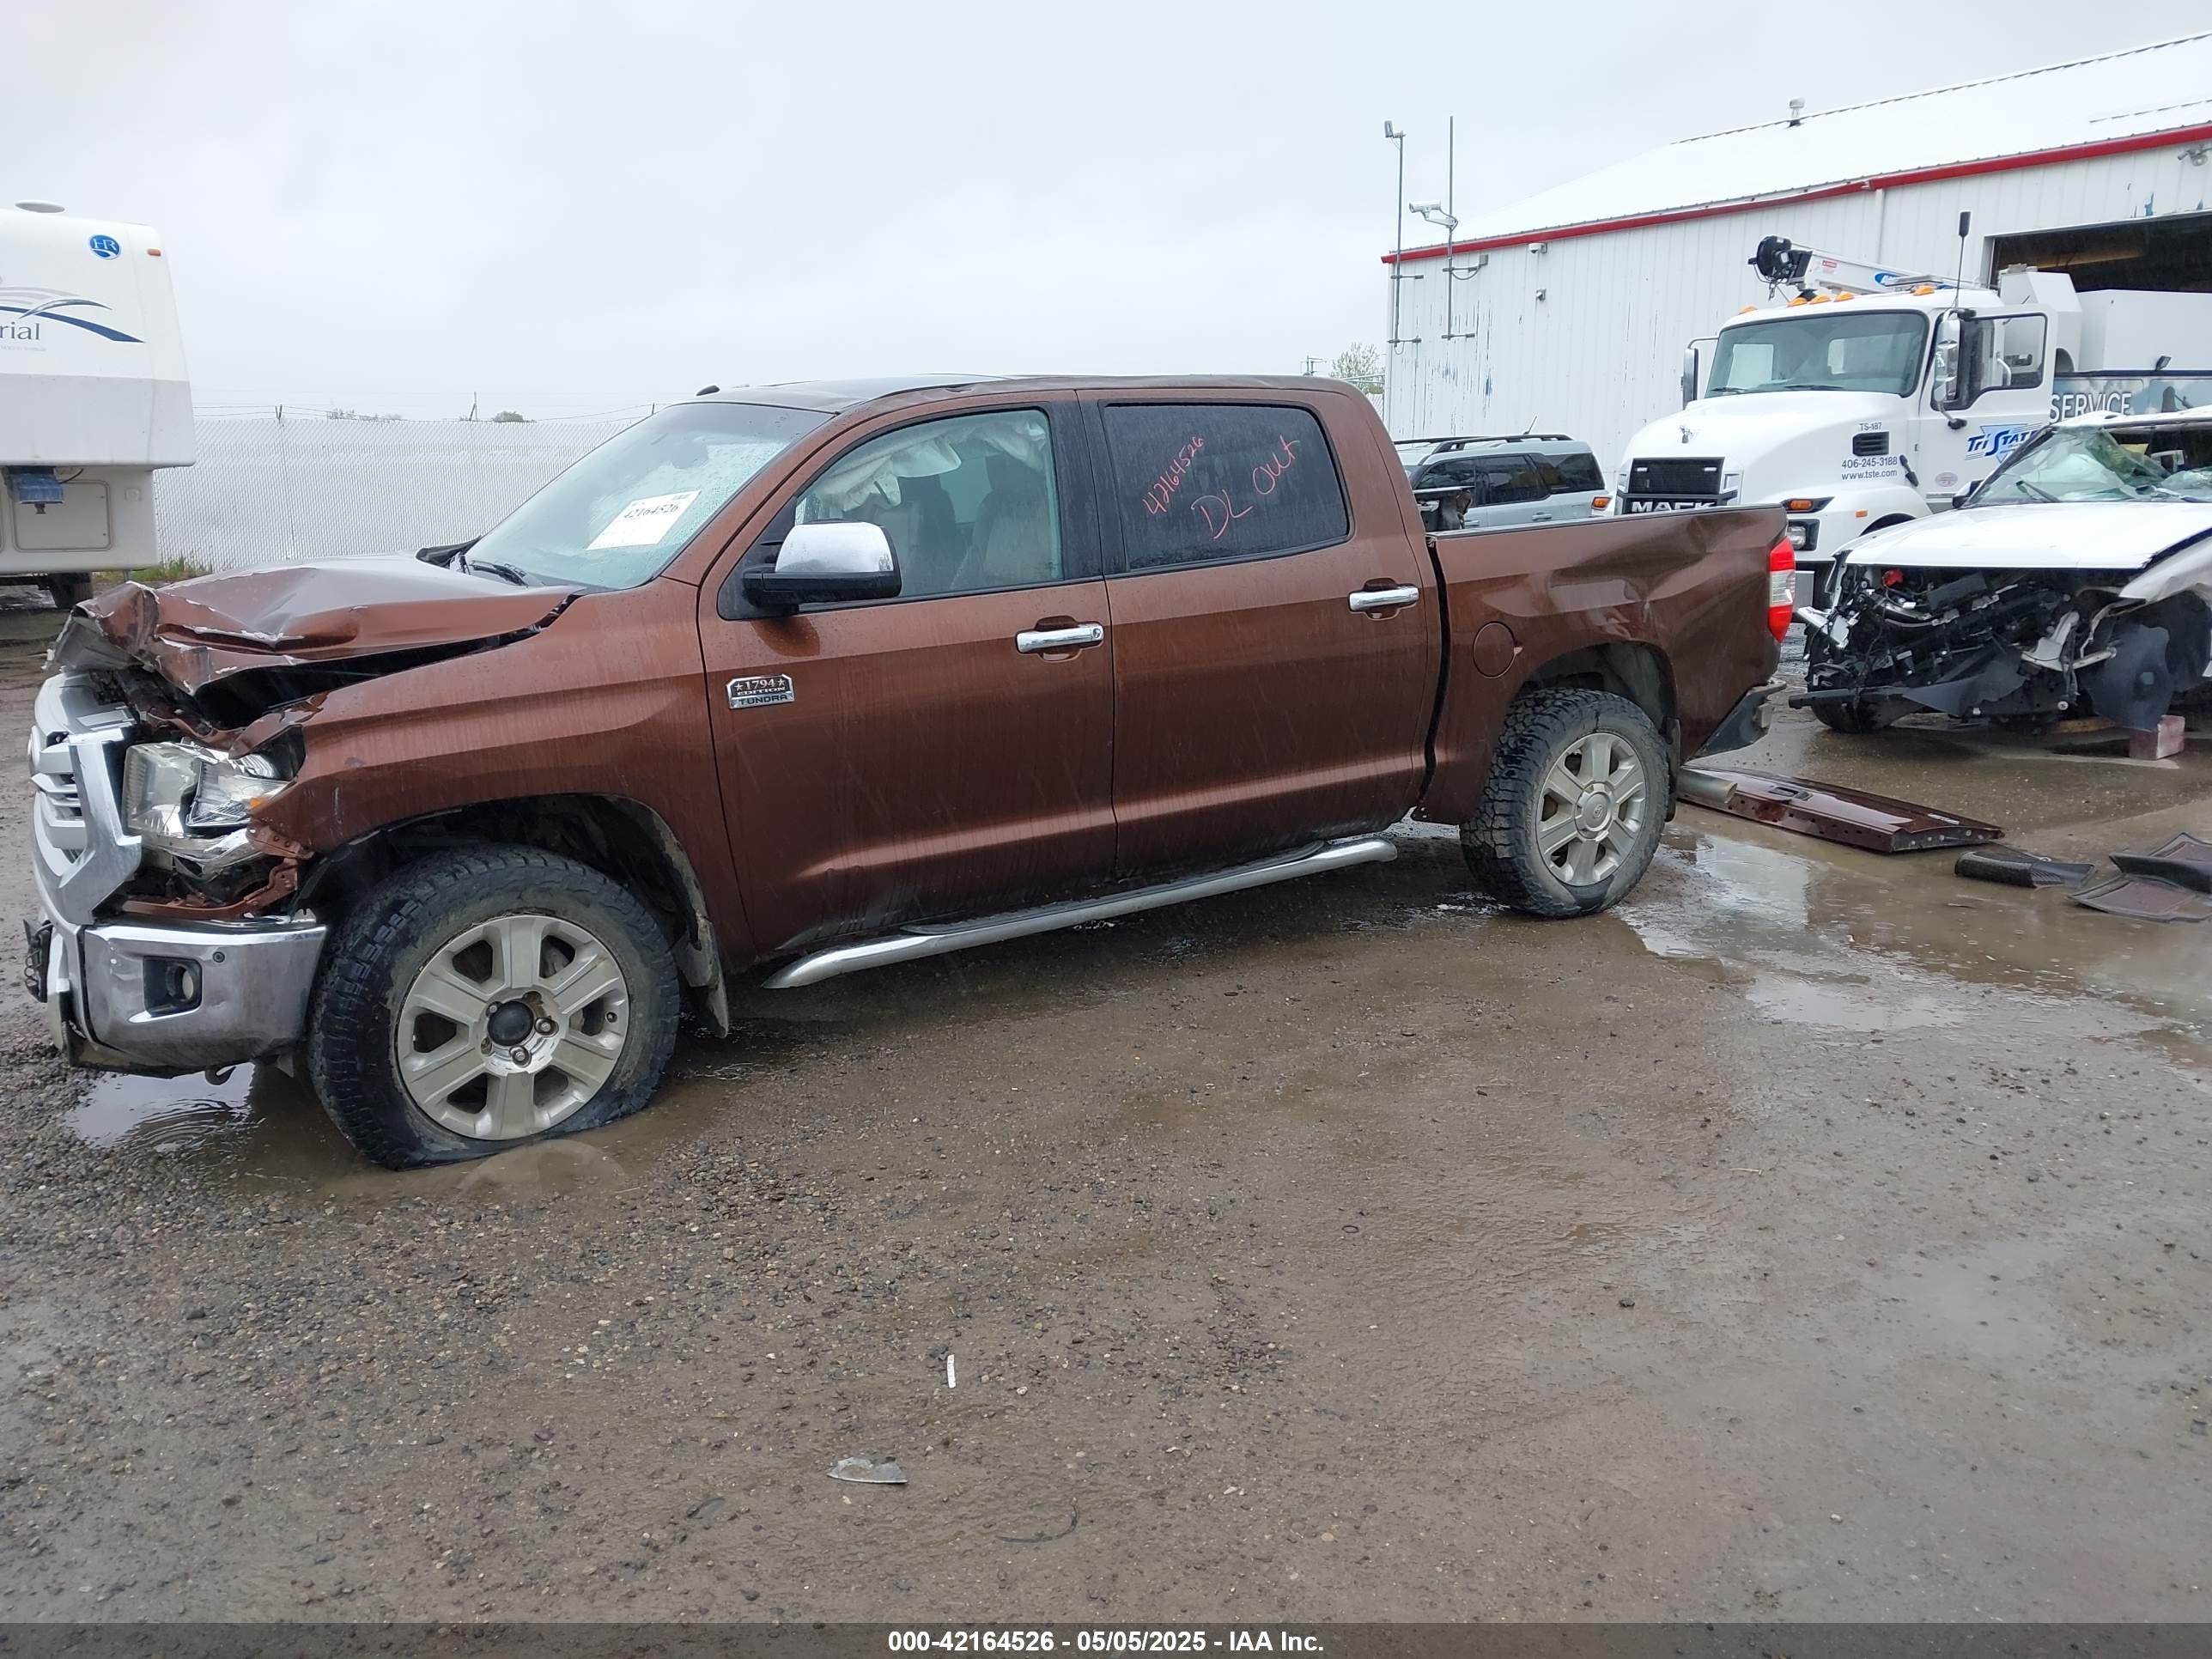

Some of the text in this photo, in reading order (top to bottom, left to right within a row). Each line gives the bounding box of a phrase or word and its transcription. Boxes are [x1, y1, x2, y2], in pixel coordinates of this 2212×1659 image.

[93, 237, 118, 251] HR
[2049, 392, 2131, 423] SERVICE
[1859, 422, 1882, 431] TS-187
[1841, 456, 1898, 469] 406-245-3188
[1142, 434, 1204, 515] 42164526
[1841, 469, 1898, 480] www.tste.com
[1190, 489, 1254, 539] DL
[744, 678, 775, 690] 1794
[737, 687, 786, 696] EDITION
[738, 695, 787, 705] TUNDRA
